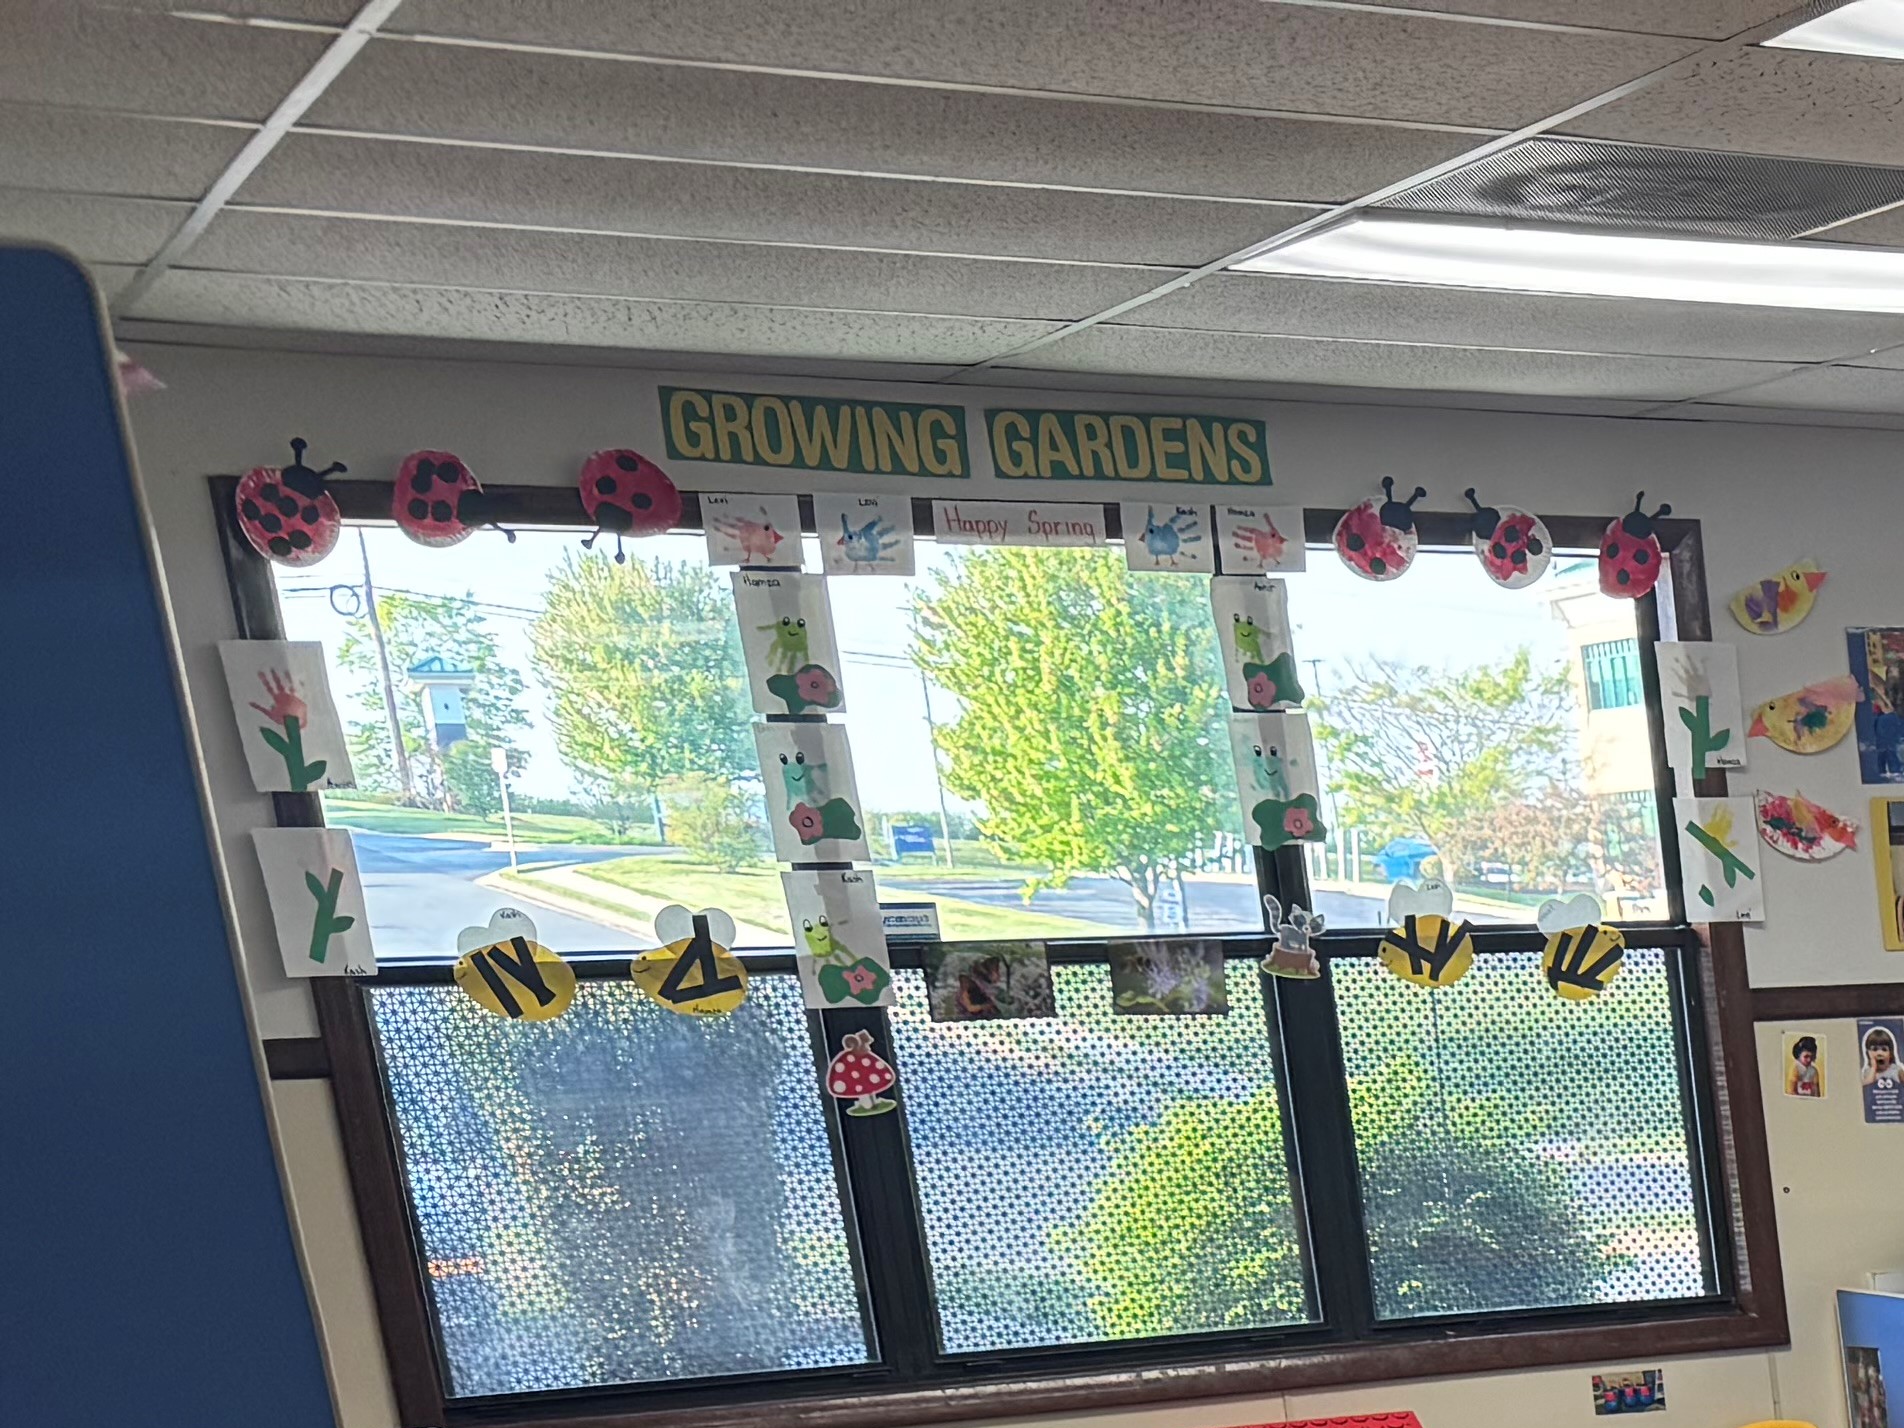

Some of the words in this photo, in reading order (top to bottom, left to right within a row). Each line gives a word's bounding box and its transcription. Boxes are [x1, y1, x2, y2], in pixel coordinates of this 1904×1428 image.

[671, 396, 964, 477] GROWING
[993, 410, 1265, 483] GARDENS
[944, 506, 1008, 542] Happy
[1028, 509, 1096, 544] Spring
